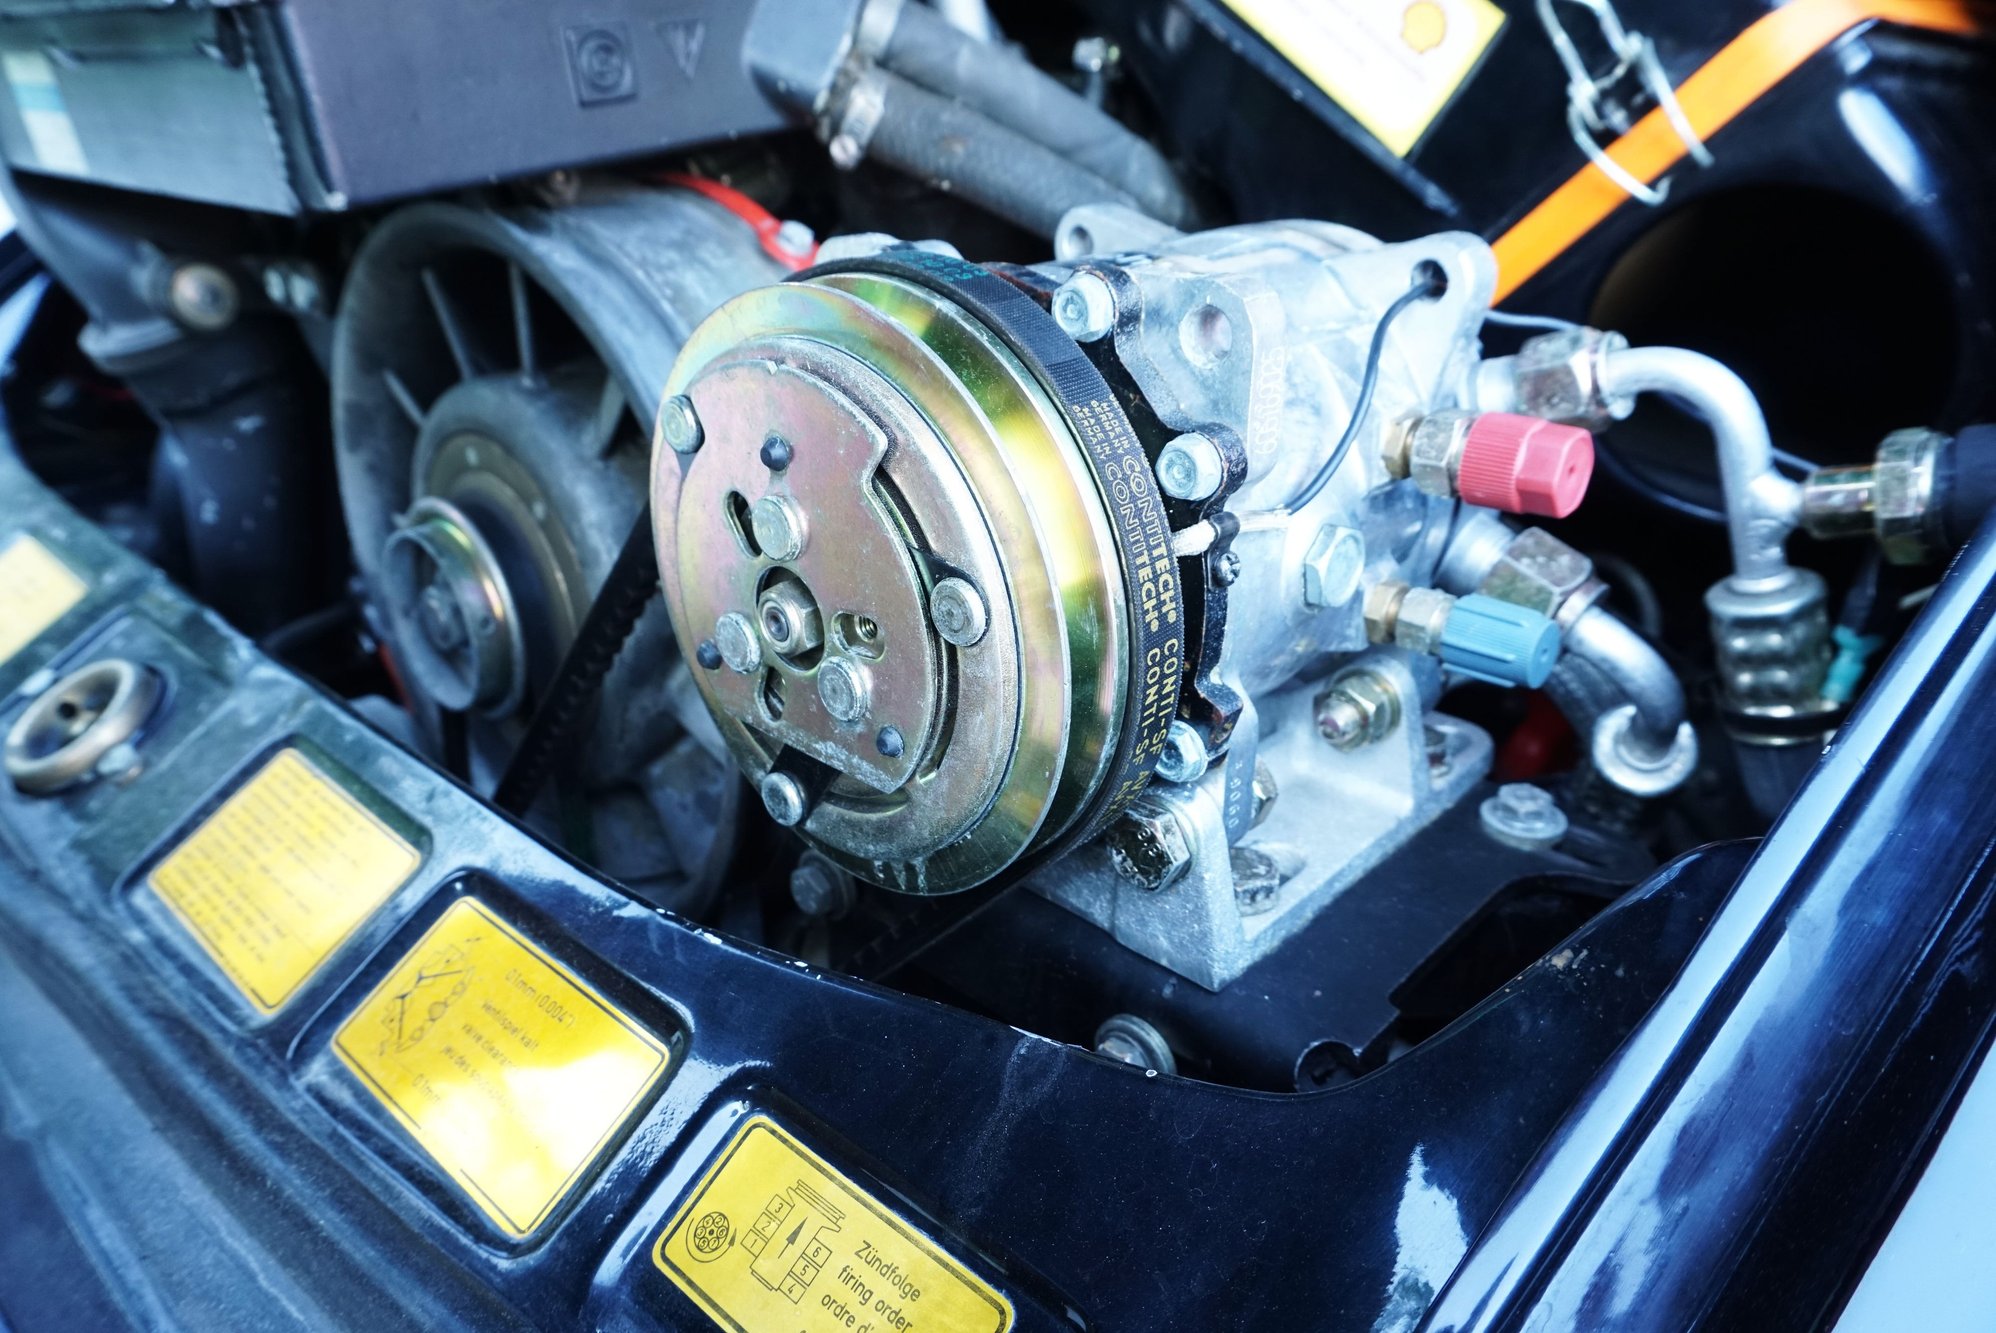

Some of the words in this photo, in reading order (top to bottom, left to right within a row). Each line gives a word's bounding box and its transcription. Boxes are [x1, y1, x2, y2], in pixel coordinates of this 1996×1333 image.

[1072, 405, 1107, 460] GERMANY
[1082, 406, 1106, 440] MADE
[1102, 443, 1112, 455] IN
[1090, 400, 1125, 454] GERMANY
[1100, 402, 1123, 434] MADE
[1120, 436, 1130, 448] IN
[1133, 647, 1161, 766] CONTI-SF
[1149, 638, 1179, 755] CONTI-SF
[761, 1221, 772, 1232] 2
[774, 1202, 784, 1214] 3
[750, 1238, 758, 1248] 1
[812, 1246, 822, 1258] 6
[787, 1283, 797, 1294] 4
[800, 1264, 810, 1276] 5
[854, 1239, 921, 1302] Zündfolge
[821, 1293, 856, 1328] ordre
[837, 1265, 874, 1306] firing
[874, 1299, 914, 1333] order
